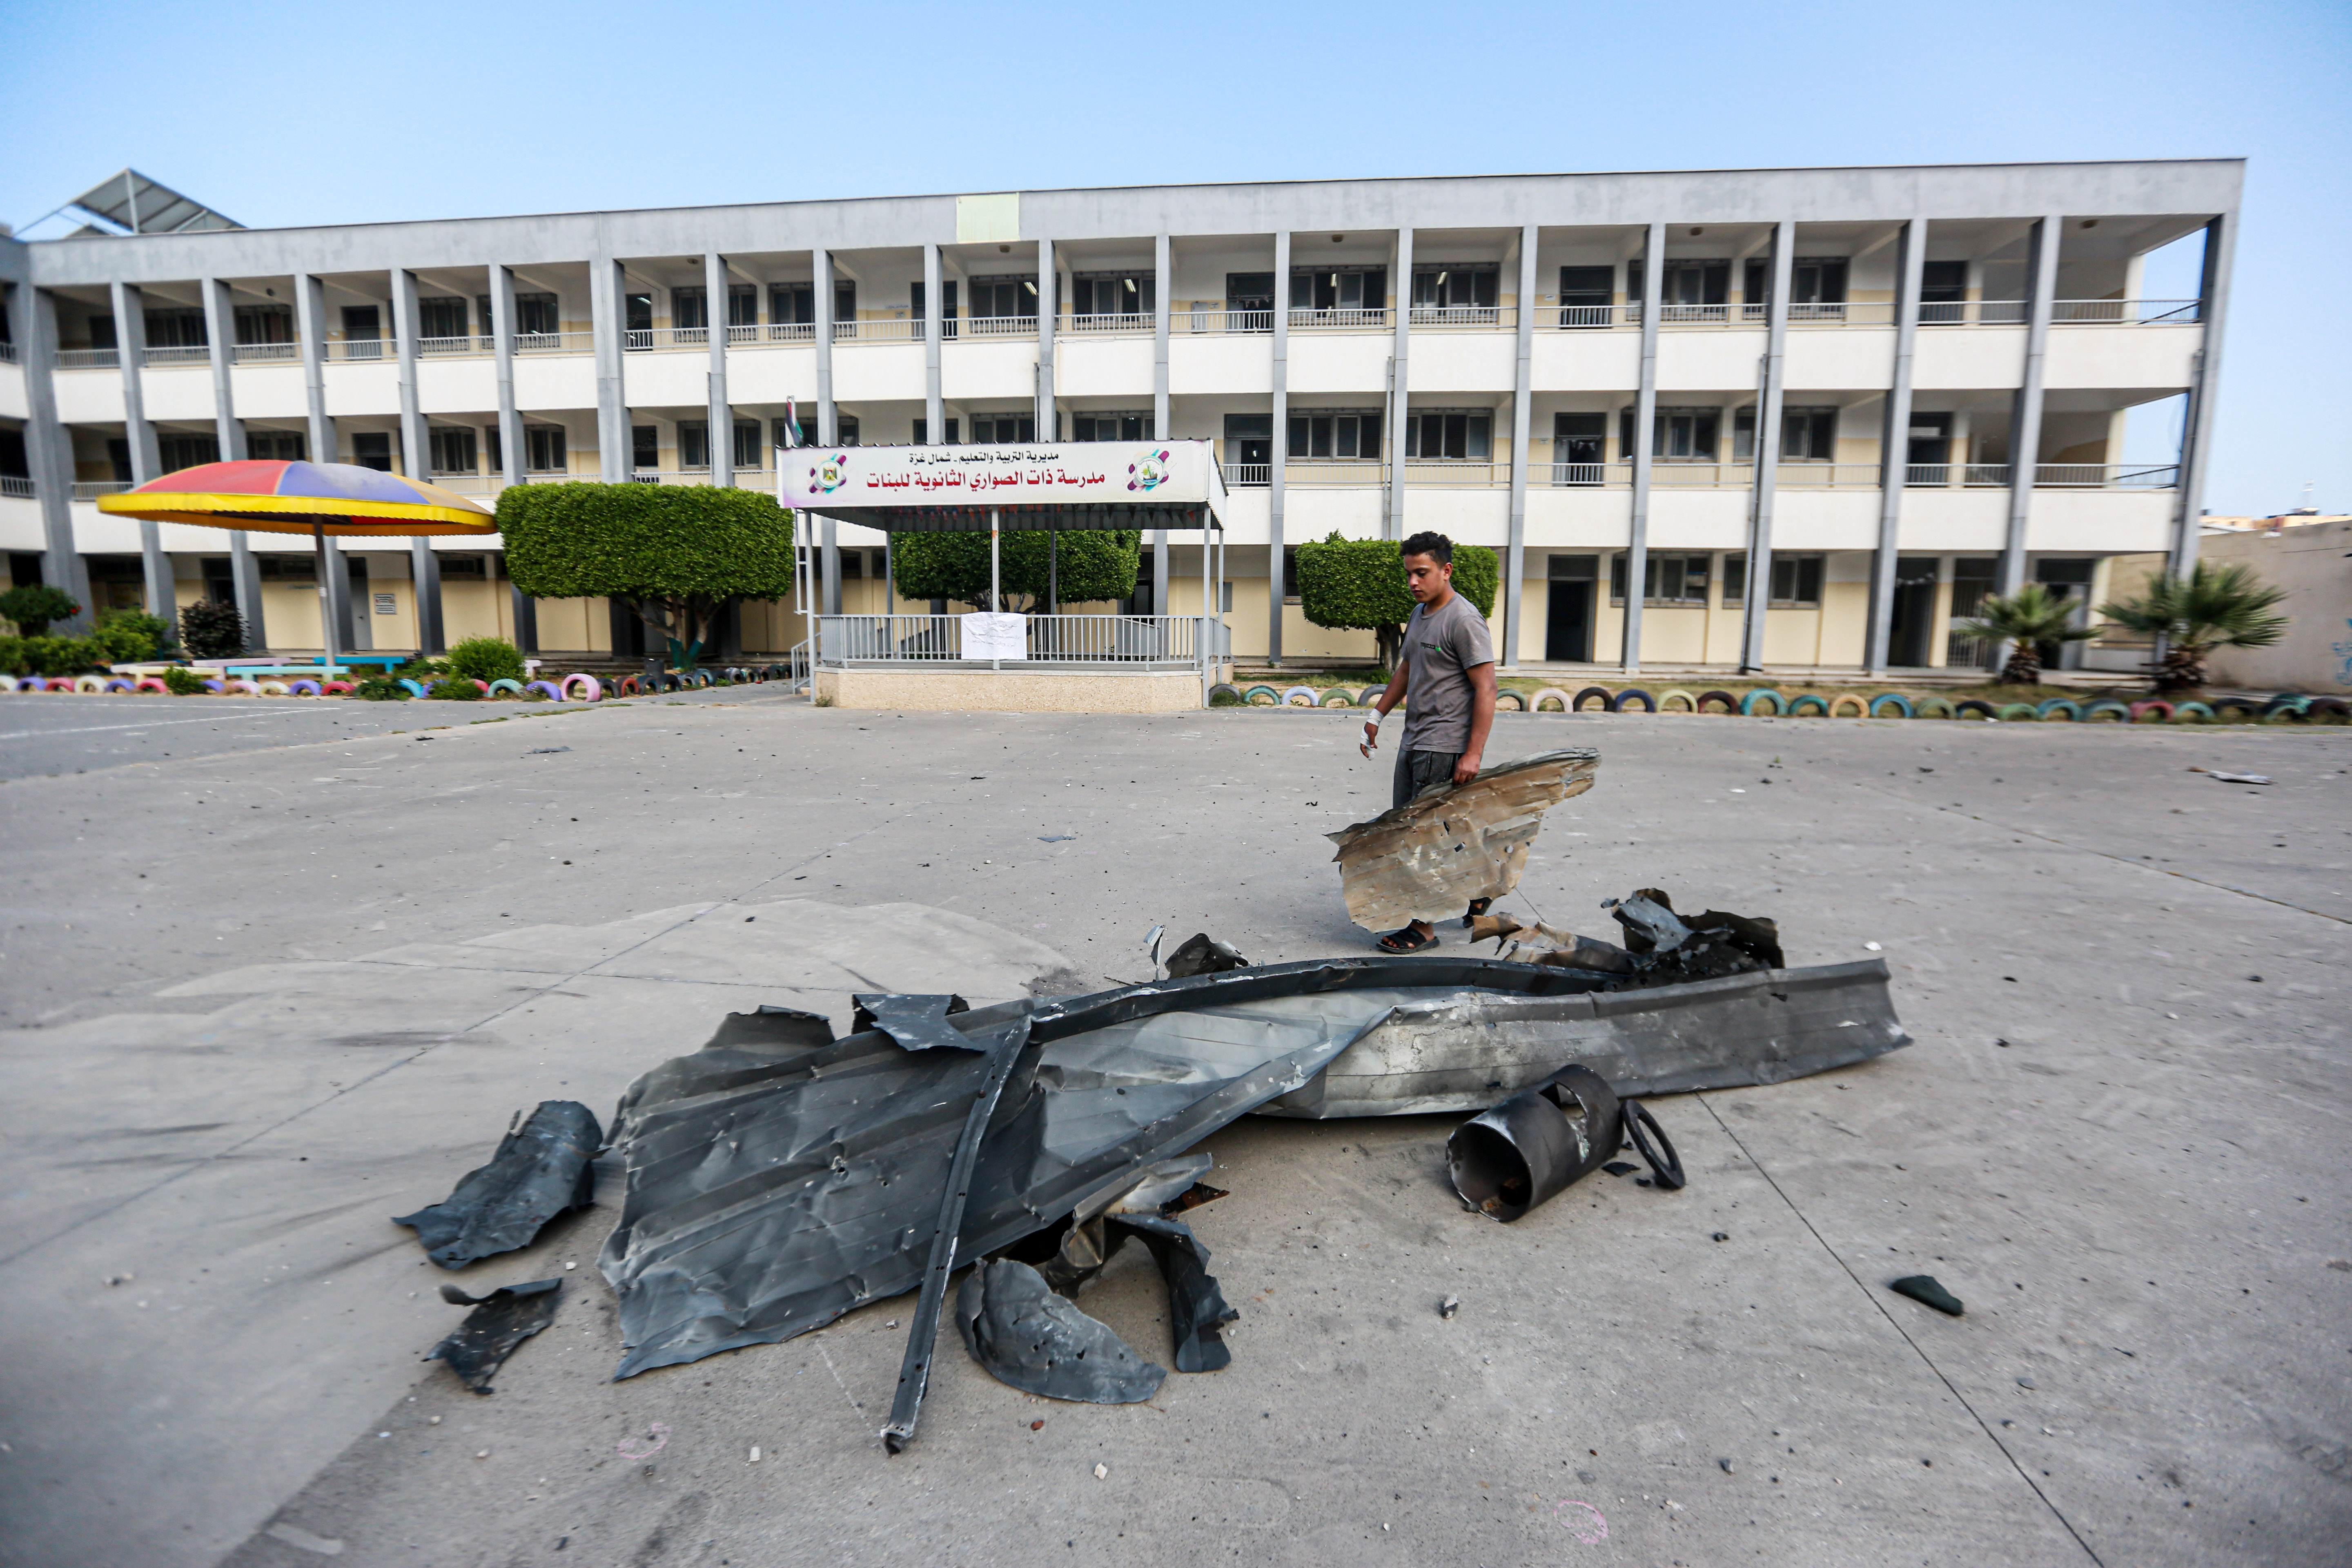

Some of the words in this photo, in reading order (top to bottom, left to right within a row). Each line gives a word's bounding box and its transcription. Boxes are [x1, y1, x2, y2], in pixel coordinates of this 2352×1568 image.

[909, 453, 925, 465] غزة
[927, 452, 951, 465] شمال
[960, 452, 993, 464] والتعليم
[996, 451, 1024, 464] التربية
[1026, 450, 1059, 463] مديرية
[866, 472, 910, 492] للبنات
[914, 469, 966, 491] الثانوية
[970, 470, 1022, 492] الصواري
[1027, 468, 1053, 484] ذات
[1057, 469, 1105, 488] مدرسة
